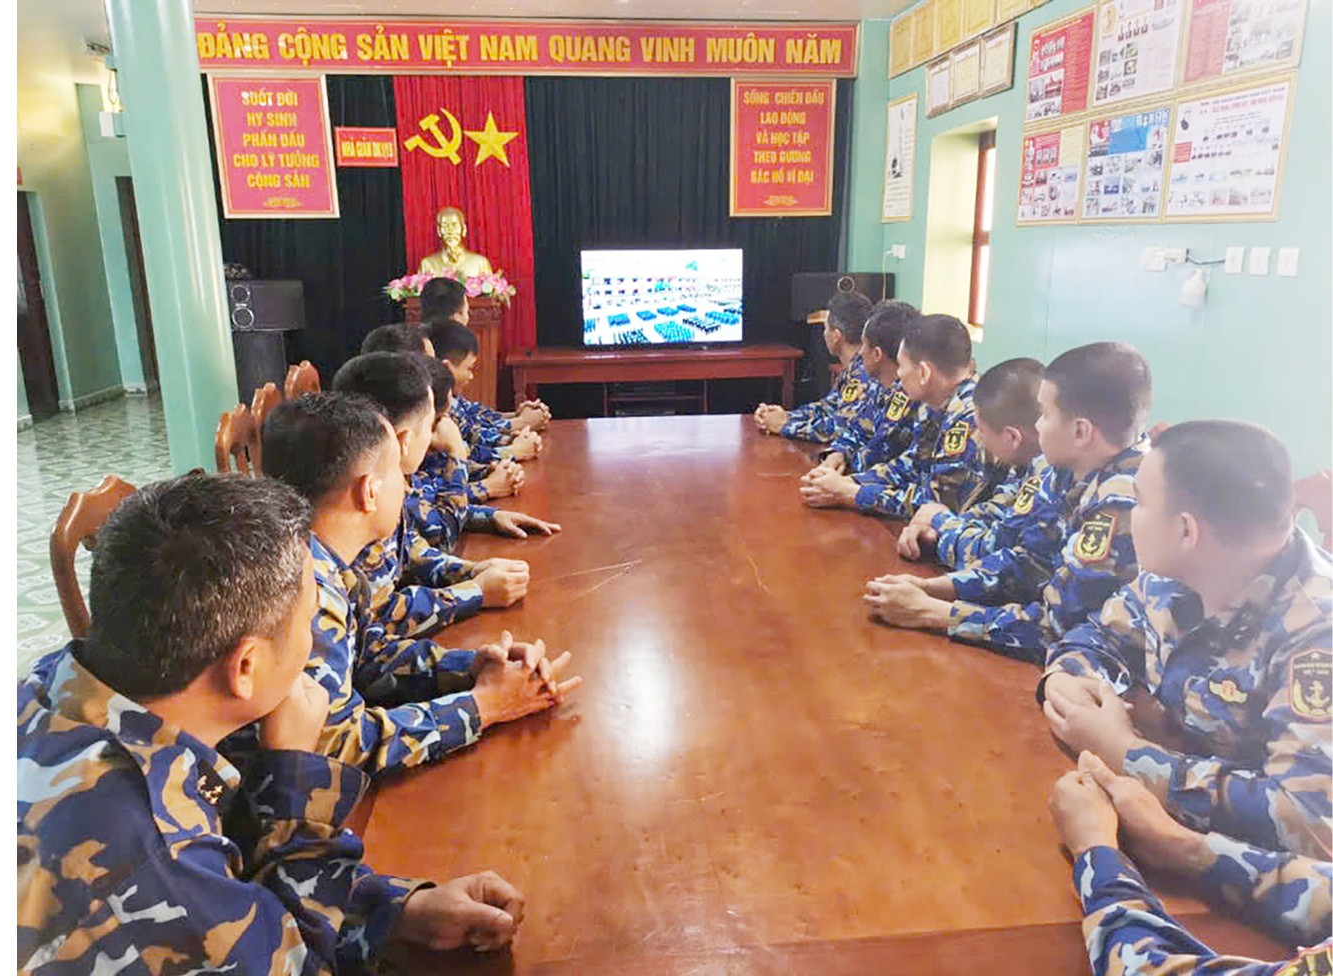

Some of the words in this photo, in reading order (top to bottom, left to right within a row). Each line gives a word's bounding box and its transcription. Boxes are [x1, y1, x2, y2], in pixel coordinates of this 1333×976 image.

[197, 23, 268, 60] ĐẢNG
[278, 27, 348, 67] CỘNG
[356, 24, 409, 61] SẢN
[418, 28, 470, 68] VIỆT
[480, 34, 538, 62] NAM
[549, 35, 631, 63] QUANG
[640, 36, 695, 63] VINH
[706, 32, 775, 64] MUÔN
[786, 33, 842, 64] NĂM
